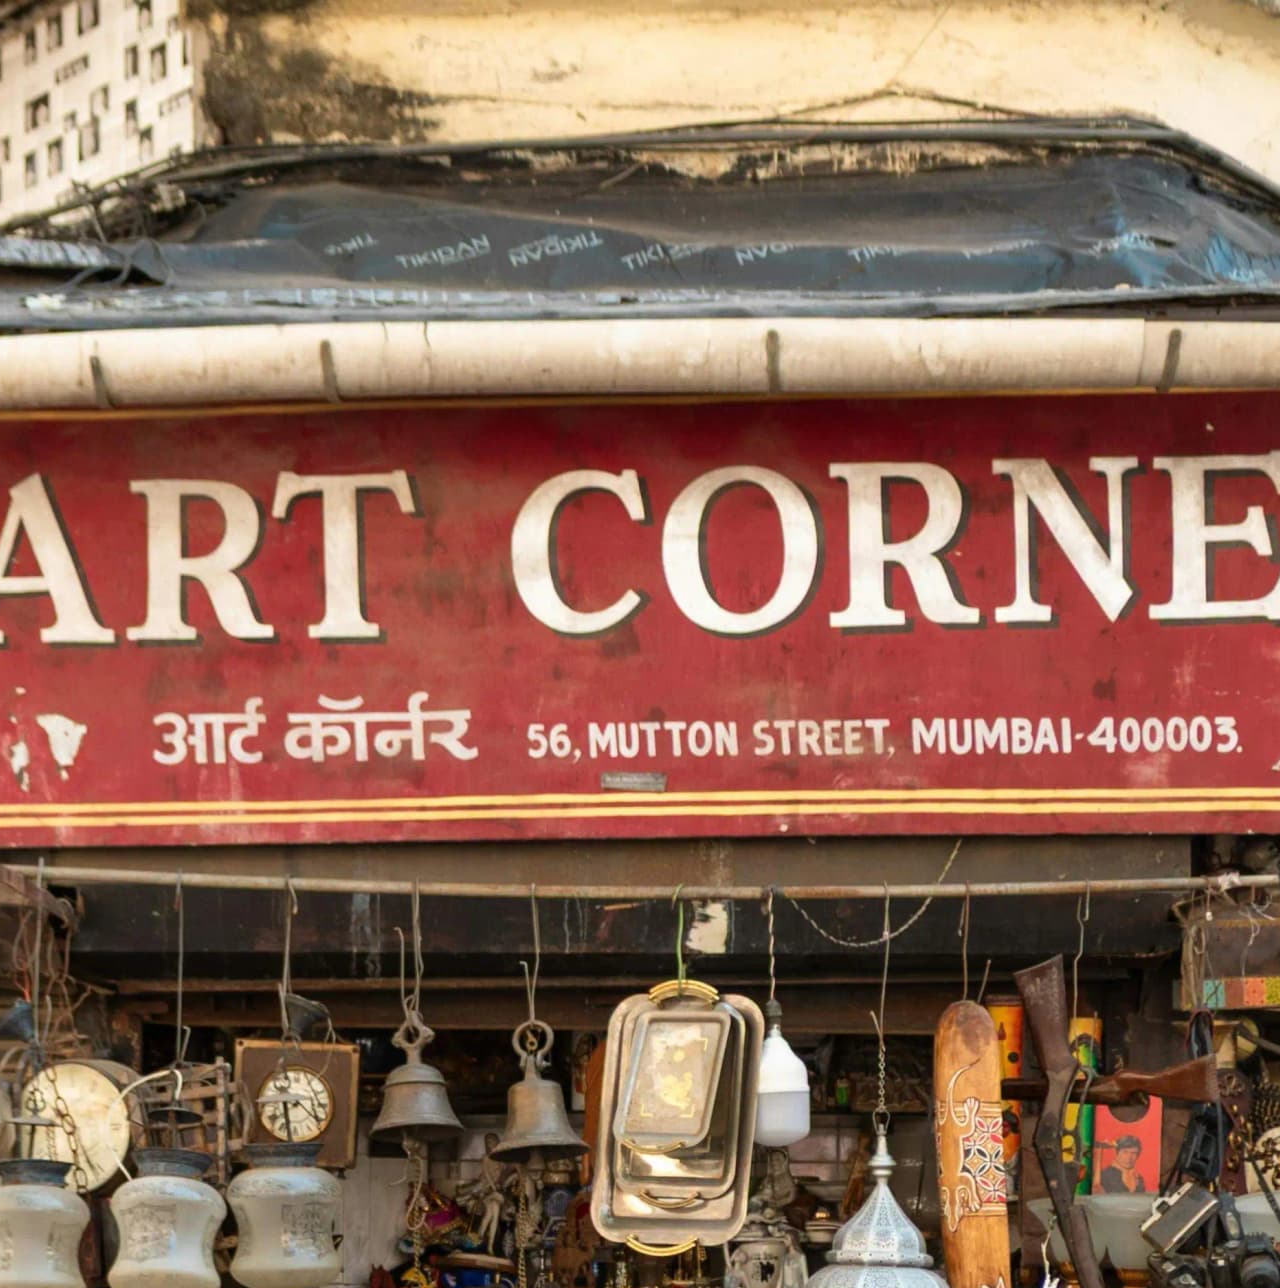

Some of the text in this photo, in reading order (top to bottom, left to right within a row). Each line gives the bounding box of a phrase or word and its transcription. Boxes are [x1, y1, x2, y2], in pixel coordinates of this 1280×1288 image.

[152, 690, 479, 766] आर्ट कॉर्नर
[526, 714, 1244, 763] 56, MUTTON STREET, MUMBAI-400003.
